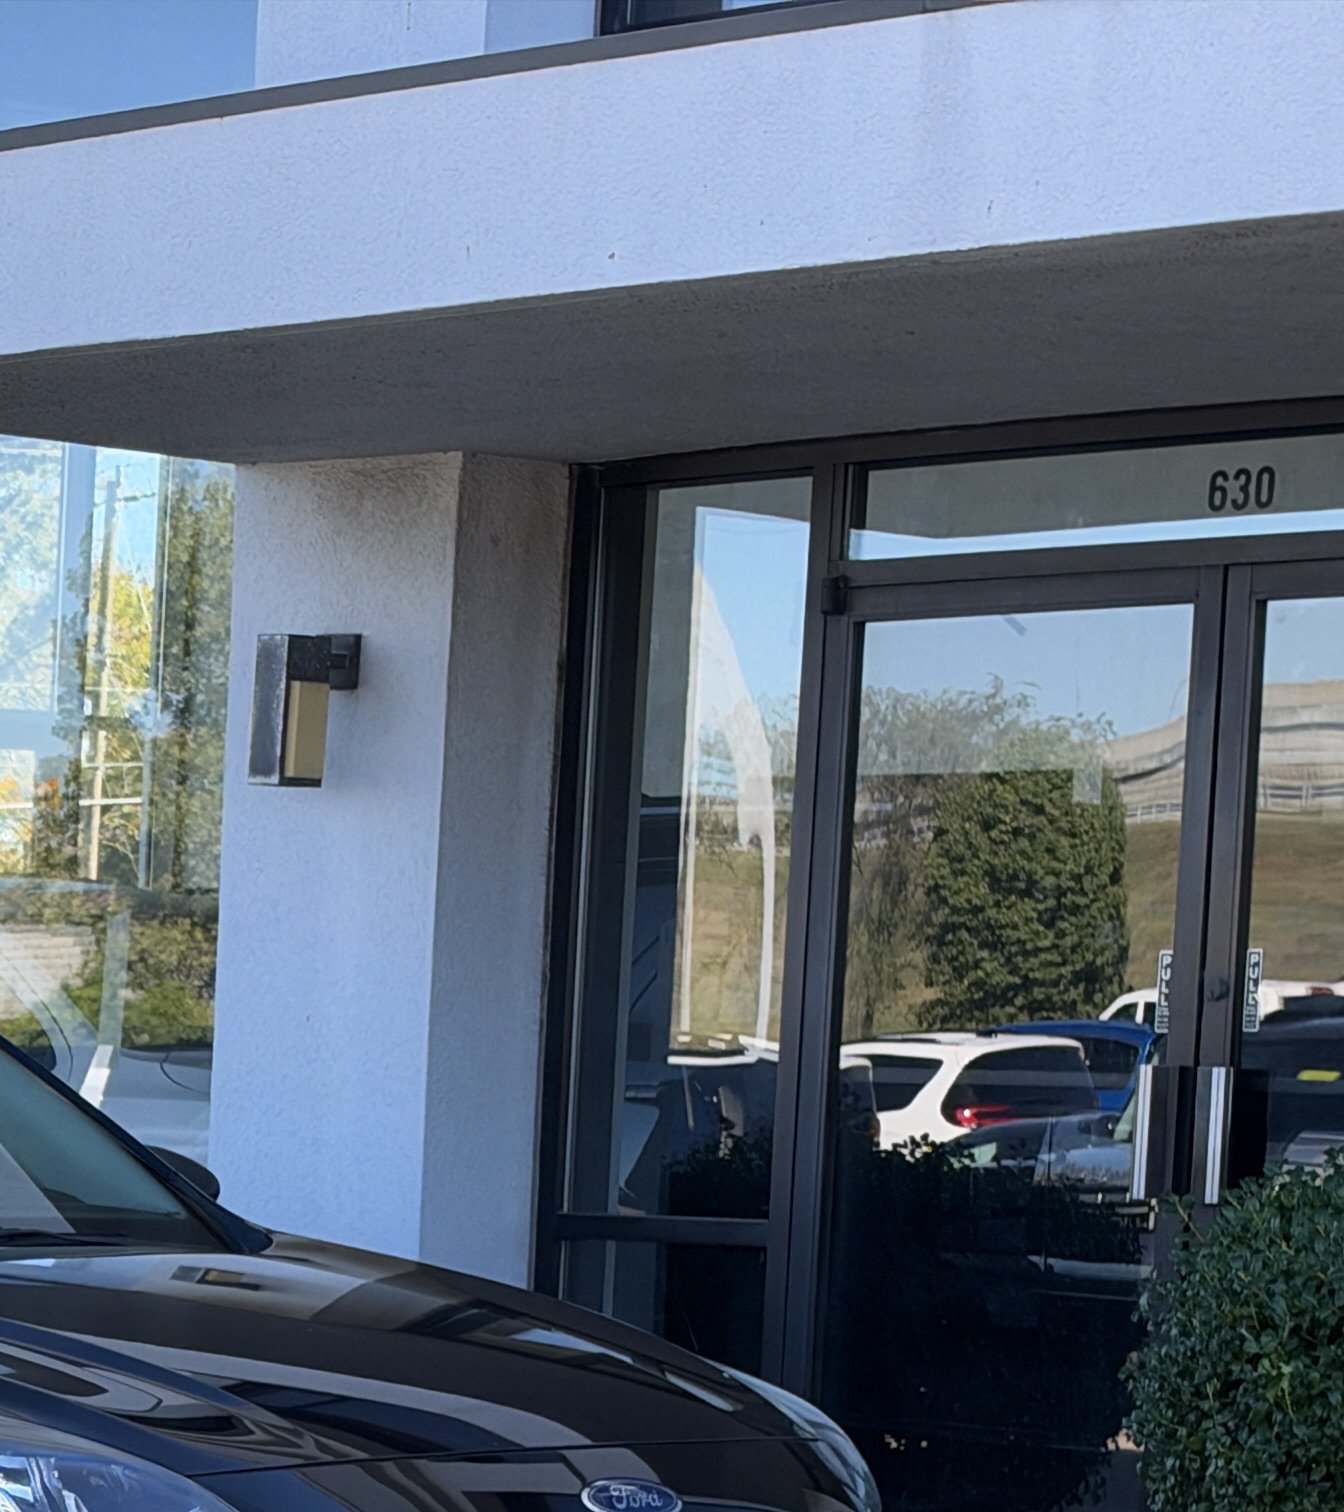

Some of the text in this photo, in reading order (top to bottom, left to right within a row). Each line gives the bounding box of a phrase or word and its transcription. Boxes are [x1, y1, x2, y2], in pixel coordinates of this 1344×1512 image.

[1208, 466, 1276, 512] 630
[1160, 955, 1172, 1006] PULL
[1248, 953, 1260, 1005] PULL
[610, 1485, 663, 1509] Ford
